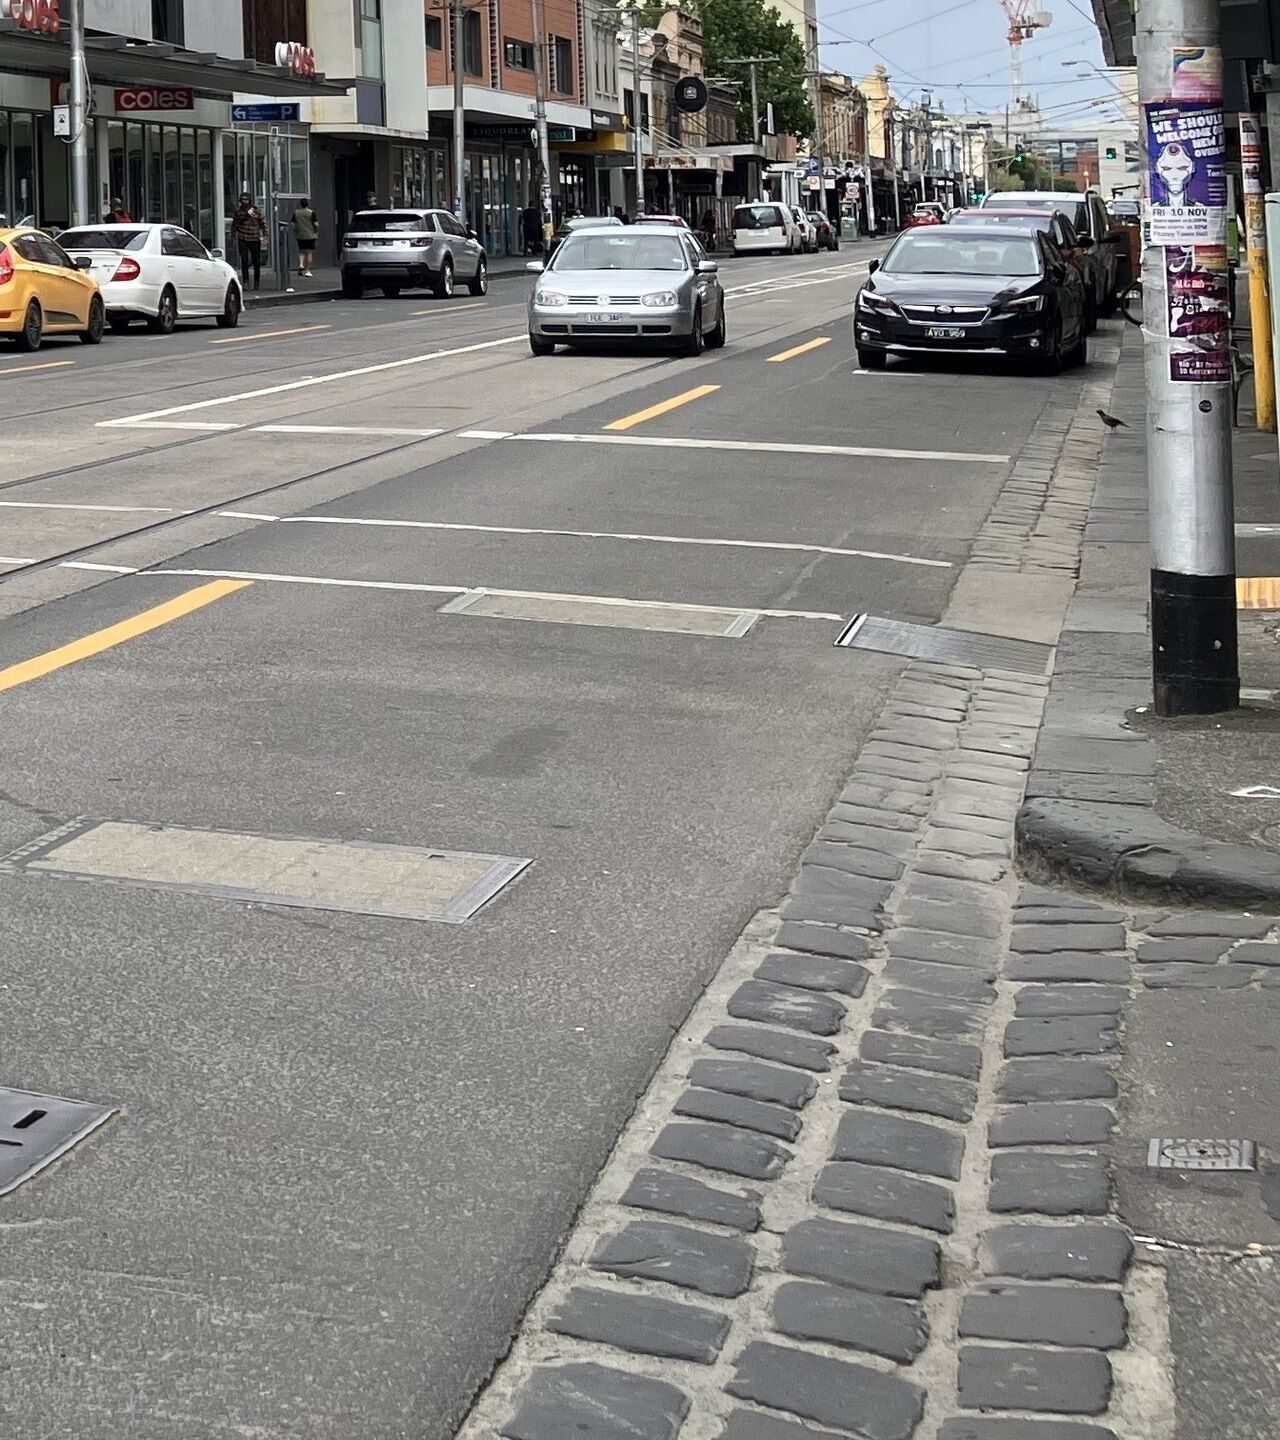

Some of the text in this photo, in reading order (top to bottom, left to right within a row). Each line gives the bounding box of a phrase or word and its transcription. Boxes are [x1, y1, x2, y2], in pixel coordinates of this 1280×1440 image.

[120, 90, 189, 109] coles
[280, 106, 293, 119] P
[1151, 121, 1173, 133] WE
[1156, 127, 1212, 144] WELCOME
[1171, 208, 1184, 216] 10
[1188, 208, 1208, 216] NOV
